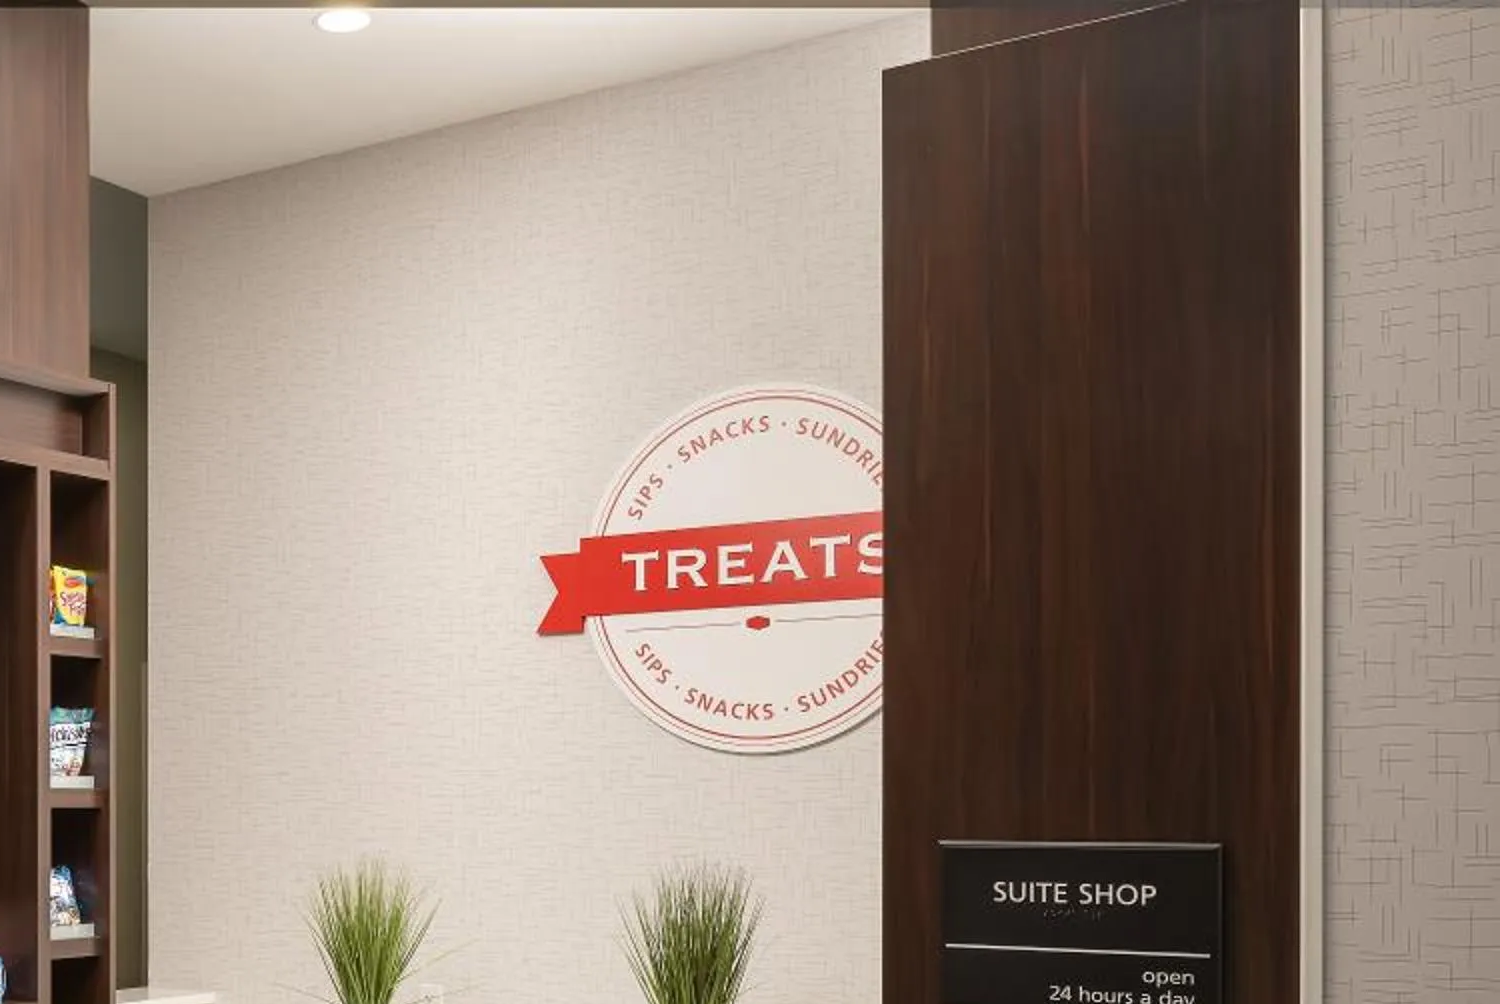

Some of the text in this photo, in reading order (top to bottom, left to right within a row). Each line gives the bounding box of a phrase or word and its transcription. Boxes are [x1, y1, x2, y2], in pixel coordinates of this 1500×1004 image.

[627, 473, 665, 521] SIPS
[676, 414, 771, 463] SNACKS
[621, 532, 884, 592] TREATS
[635, 633, 884, 721] SIPS SNACKS SUNDRIE
[993, 881, 1157, 906] SUITE SHOP
[1049, 985, 1072, 1001] 24
[1079, 986, 1133, 1004] hours
[1142, 970, 1195, 988] open
